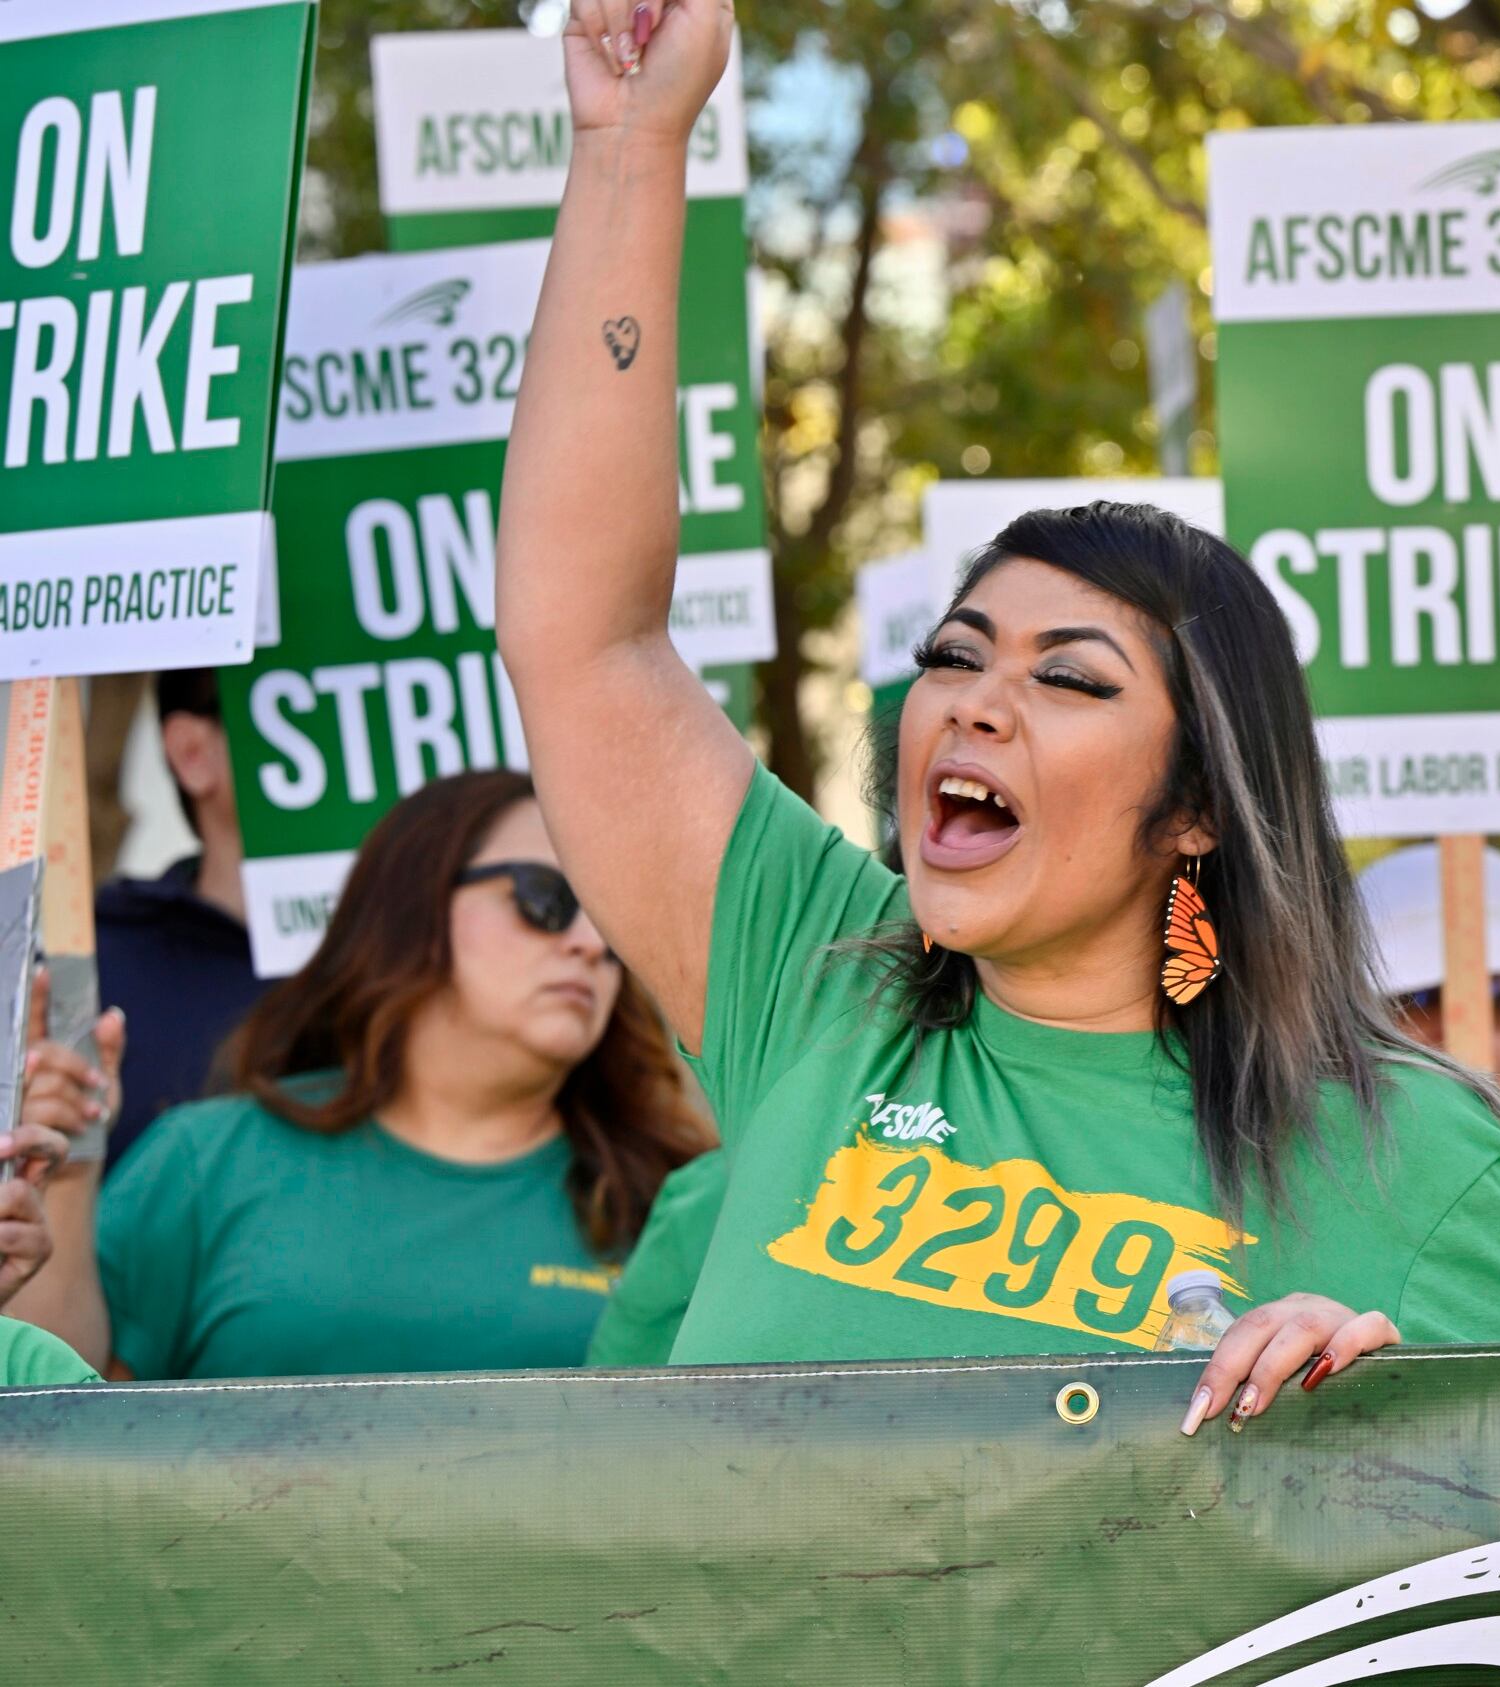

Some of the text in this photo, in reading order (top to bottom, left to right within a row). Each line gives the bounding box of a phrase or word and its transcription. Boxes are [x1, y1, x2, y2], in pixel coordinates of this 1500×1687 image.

[10, 85, 157, 269] ON
[416, 110, 571, 176] AFSCM
[1244, 209, 1470, 286] AFSCME
[0, 273, 253, 468] RIKE
[283, 331, 532, 423] SCME 32
[82, 564, 238, 626] PRACTICE
[345, 489, 498, 641] ON
[249, 651, 532, 811] STRI
[1379, 751, 1488, 798] LABOR
[824, 1154, 1176, 1334] 3299
